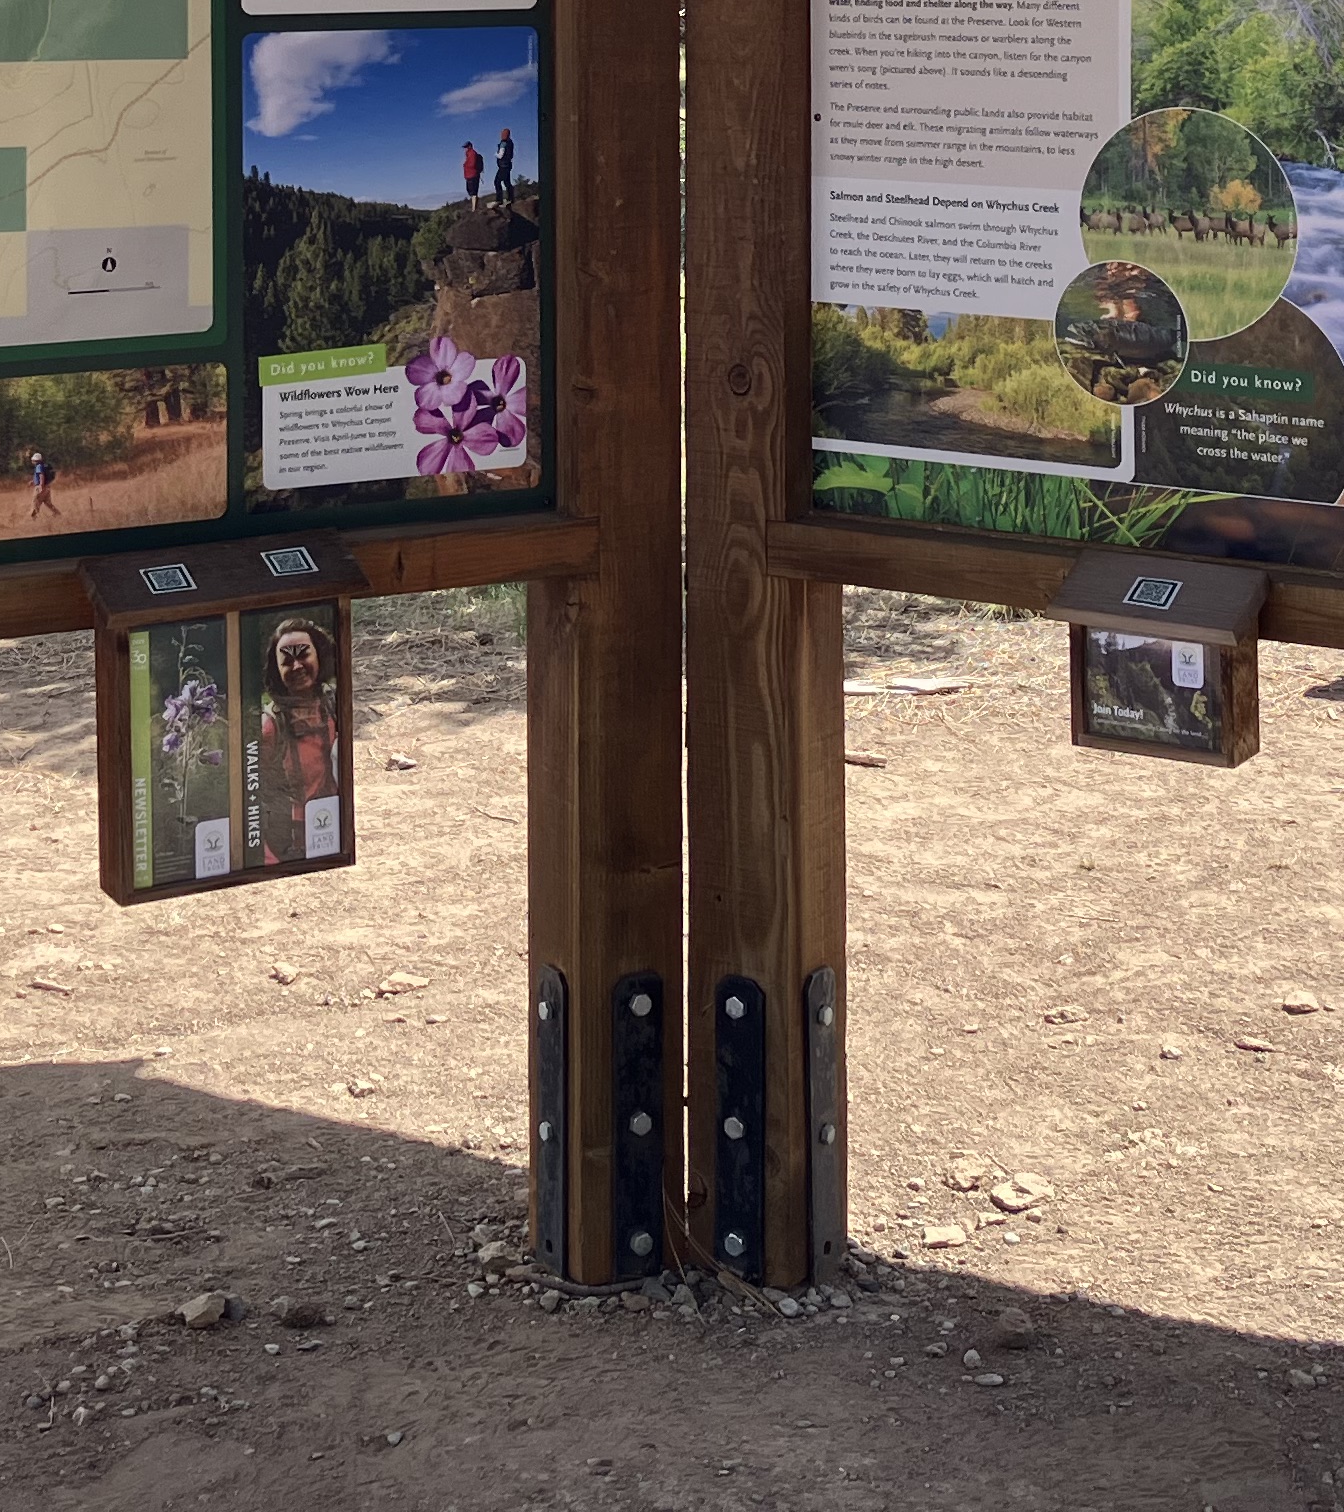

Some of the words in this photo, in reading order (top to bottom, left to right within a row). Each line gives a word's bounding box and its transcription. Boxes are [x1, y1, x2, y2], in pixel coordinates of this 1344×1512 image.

[829, 191, 864, 201] Salmon
[865, 193, 883, 202] and
[885, 194, 930, 205] Steelhead
[932, 197, 969, 209] Depend
[985, 200, 1030, 212] Whychus
[1031, 203, 1060, 213] Creek
[270, 362, 295, 375] Did
[300, 361, 325, 375] you
[330, 351, 375, 369] know?
[1190, 370, 1216, 384] Did
[1222, 376, 1248, 388] you
[1254, 374, 1302, 392] know?
[279, 389, 342, 402] Wildflowers
[343, 386, 371, 396] Wow
[373, 384, 399, 394] Here
[1163, 403, 1214, 418] Whychus
[1215, 407, 1226, 418] is
[1229, 411, 1234, 419] a
[1237, 410, 1289, 425] Sahaptin
[1291, 418, 1325, 428] name
[1179, 426, 1229, 441] meaning
[1258, 429, 1289, 444] place
[1291, 437, 1308, 446] we
[1196, 447, 1227, 457] cross
[1229, 447, 1249, 459] the
[1092, 702, 1111, 715] Join
[1113, 705, 1144, 720] Today!
[246, 740, 259, 791] WALKS
[133, 778, 147, 871] NEWSLETTER
[248, 805, 260, 848] HIKES
